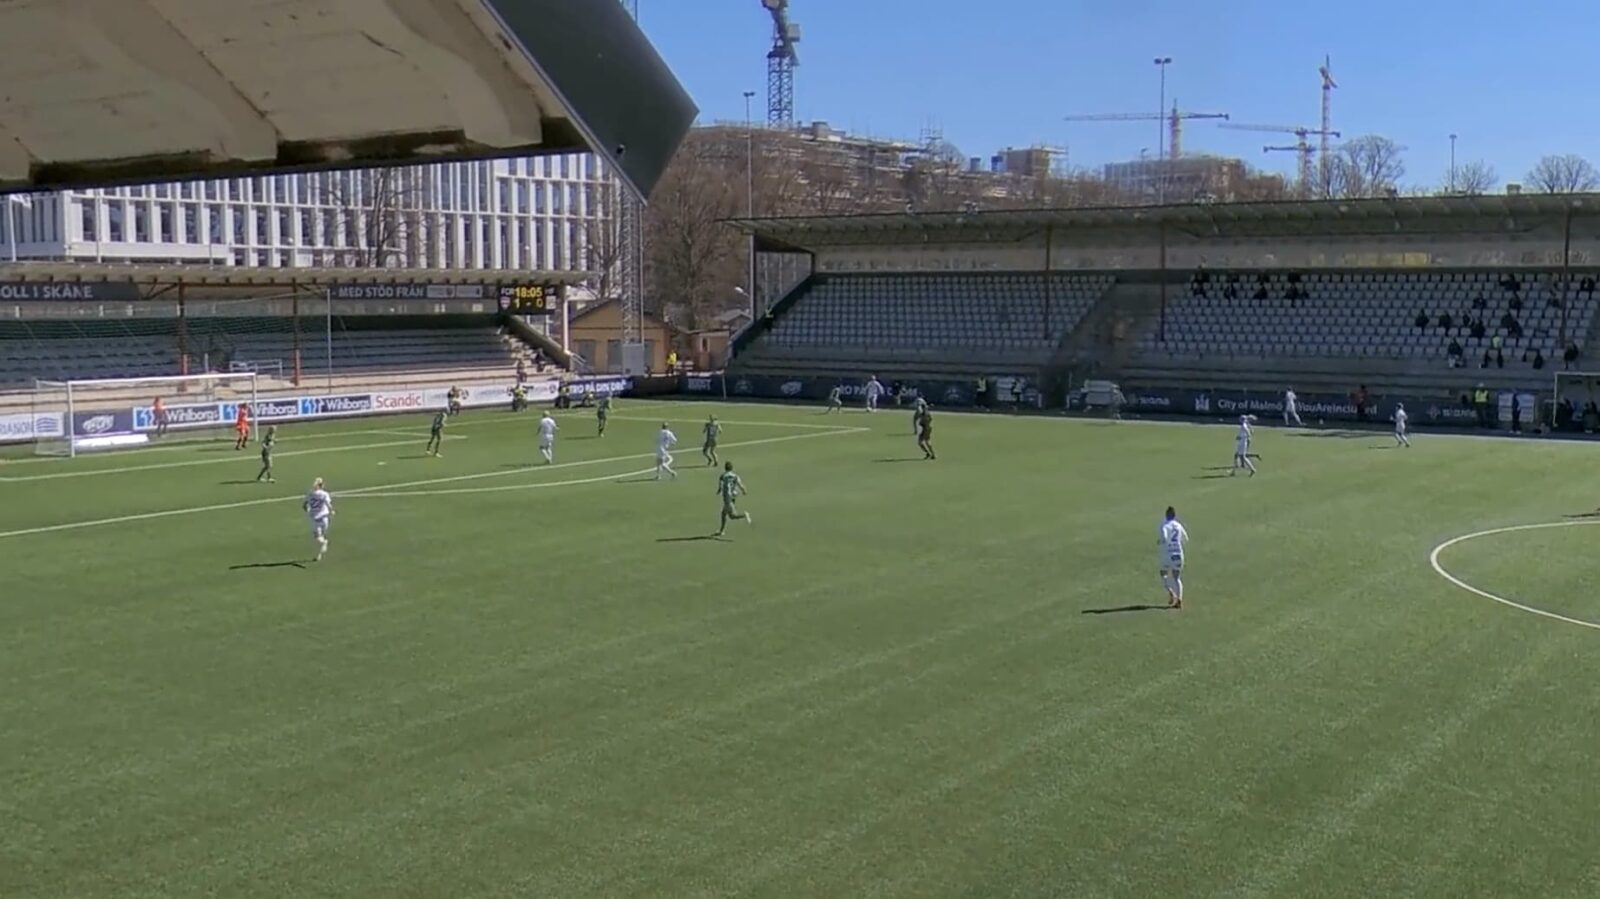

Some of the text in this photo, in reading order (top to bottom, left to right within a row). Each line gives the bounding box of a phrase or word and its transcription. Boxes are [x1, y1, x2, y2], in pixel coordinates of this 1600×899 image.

[44, 283, 93, 298] SKÅNE
[338, 286, 363, 297] MED
[366, 285, 394, 297] STÖD
[396, 285, 424, 297] FRÅN
[515, 287, 542, 298] 18:05
[514, 298, 520, 308] 1
[536, 298, 543, 308] 0
[326, 396, 370, 411] Wihlborgs
[376, 393, 422, 408] Scandic
[1217, 399, 1283, 410] City of Malmö
[166, 408, 218, 423] Wihlborgs
[1171, 528, 1179, 542] 2
